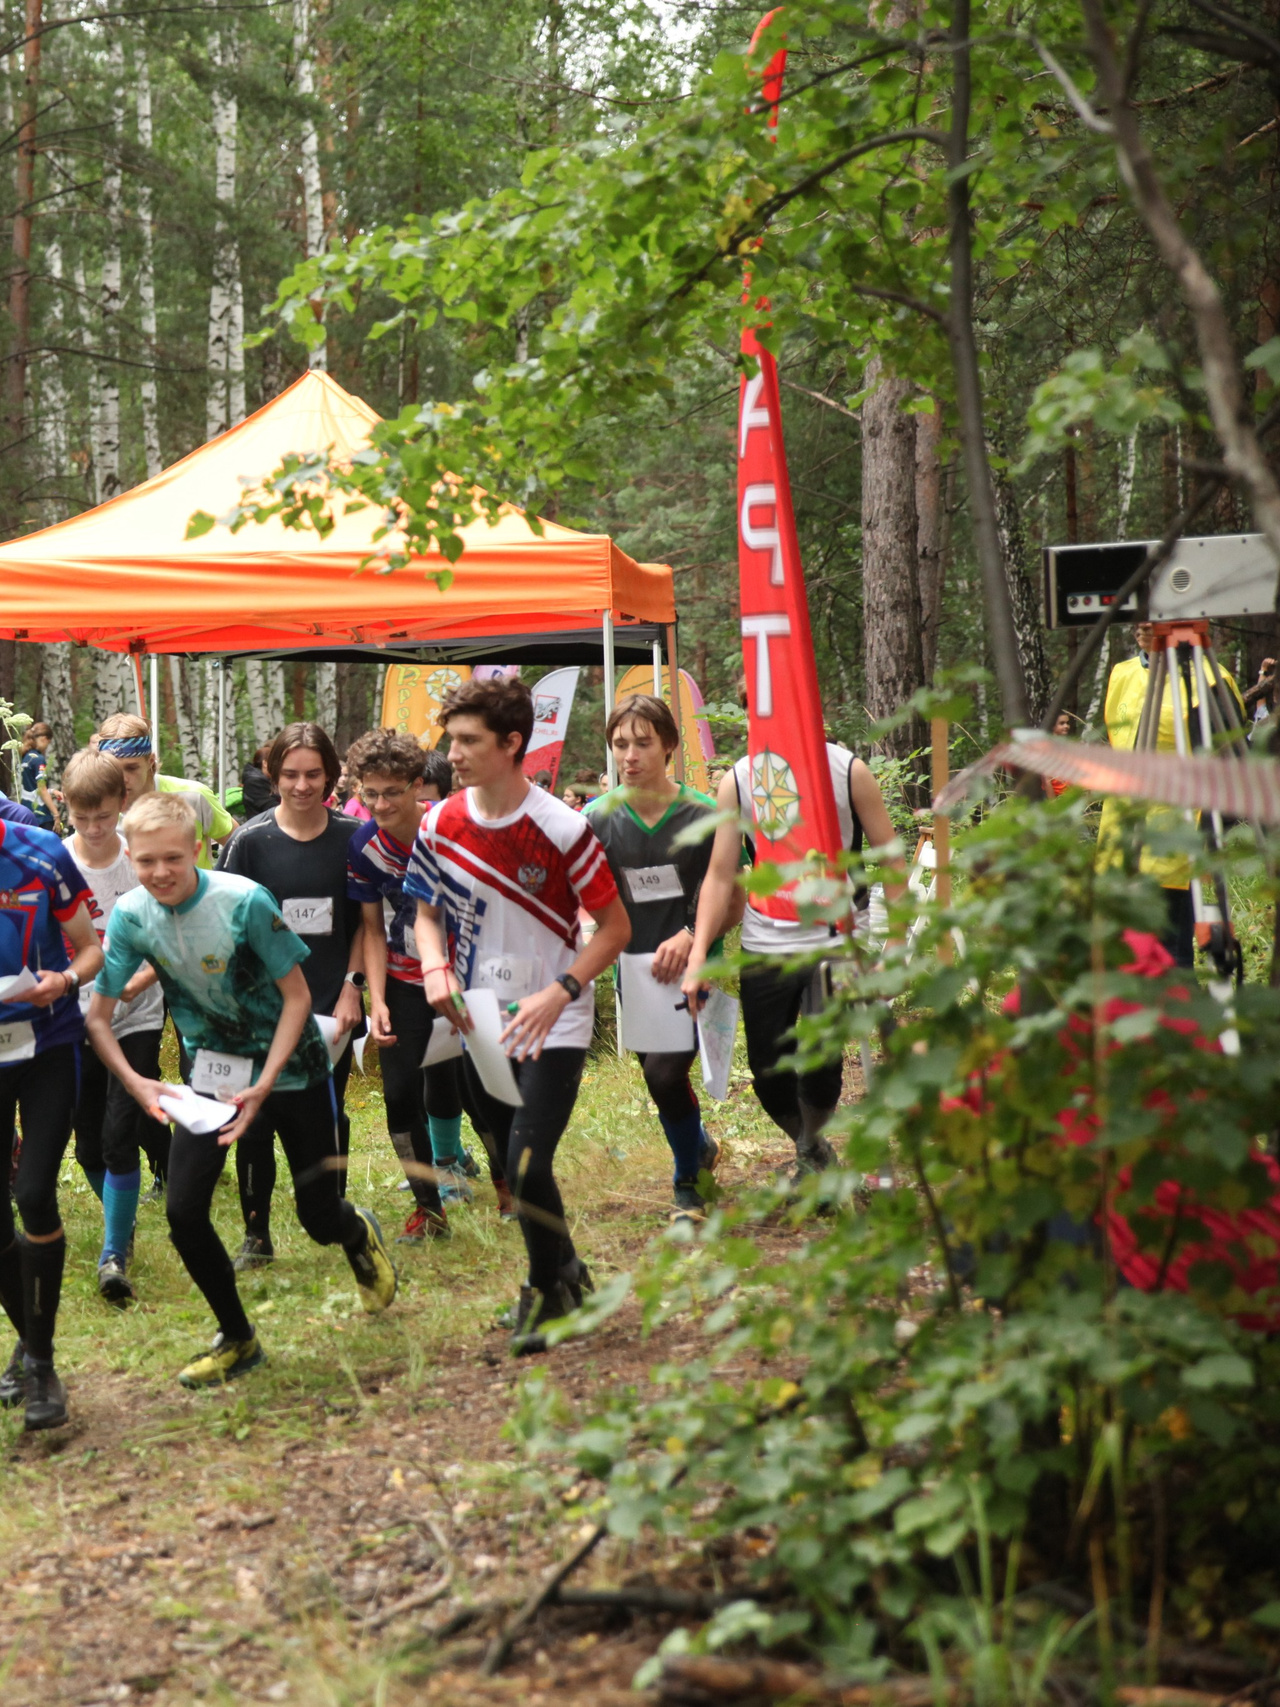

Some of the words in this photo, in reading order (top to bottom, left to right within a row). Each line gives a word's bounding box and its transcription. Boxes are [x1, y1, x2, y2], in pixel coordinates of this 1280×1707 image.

[638, 874, 660, 885] 149
[295, 907, 316, 919] 147
[490, 965, 512, 981] 140
[207, 1061, 232, 1077] 139
